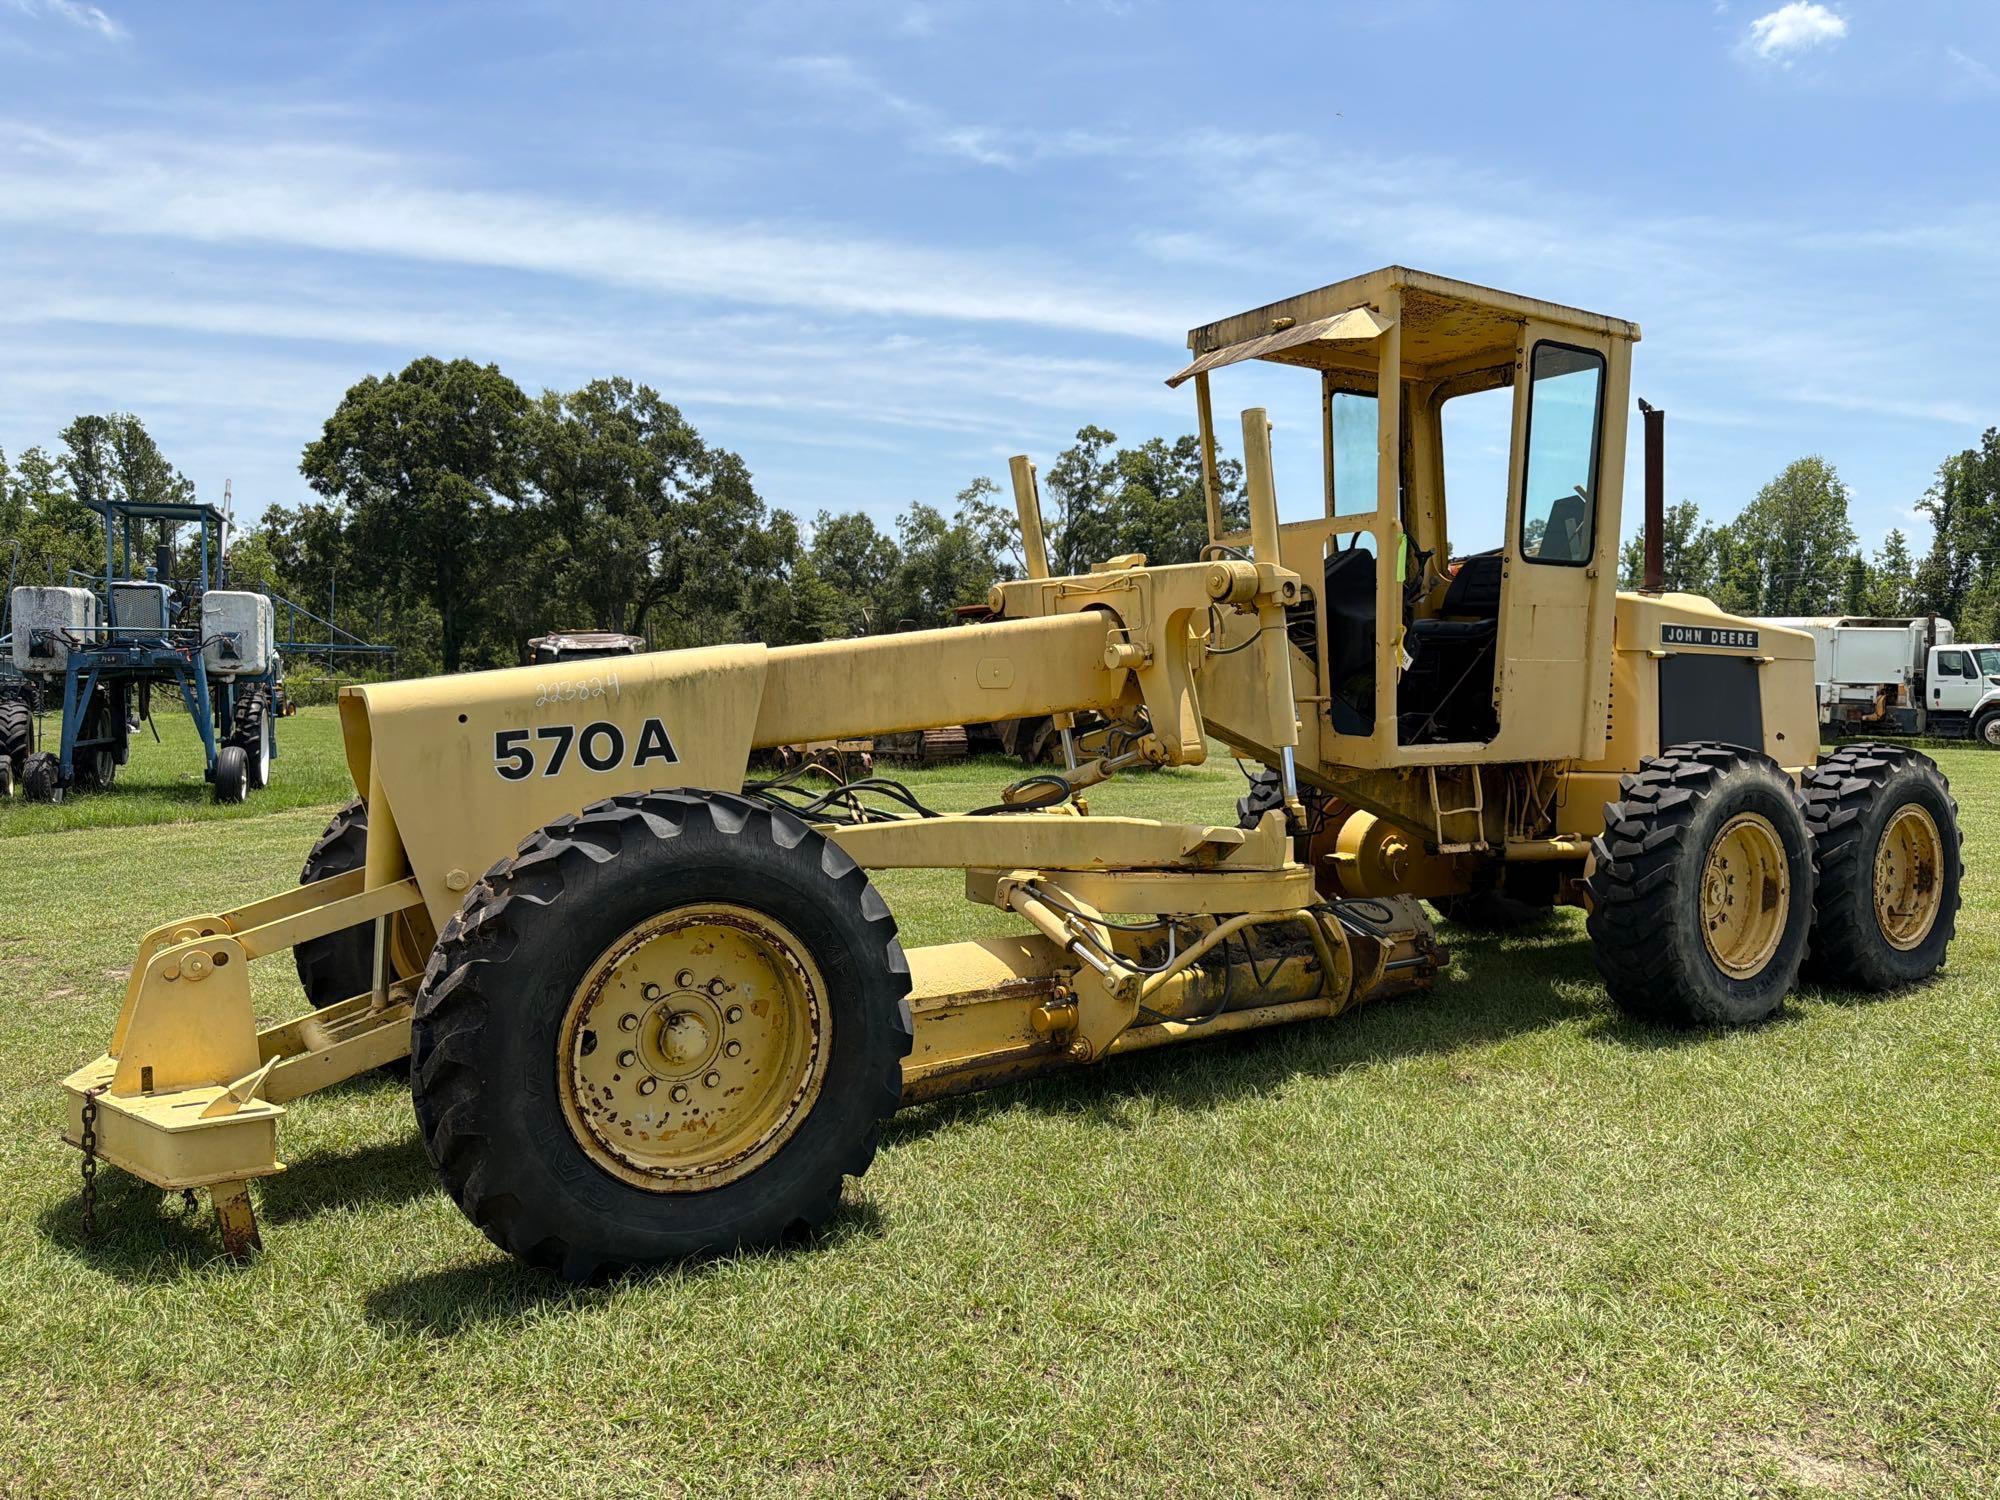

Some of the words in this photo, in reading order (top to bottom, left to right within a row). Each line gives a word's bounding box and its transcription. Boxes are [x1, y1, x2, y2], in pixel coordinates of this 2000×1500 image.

[1668, 628, 1702, 642] JOHN
[1711, 631, 1753, 645] DEERE
[535, 672, 620, 707] 223824
[493, 716, 681, 782] 570A
